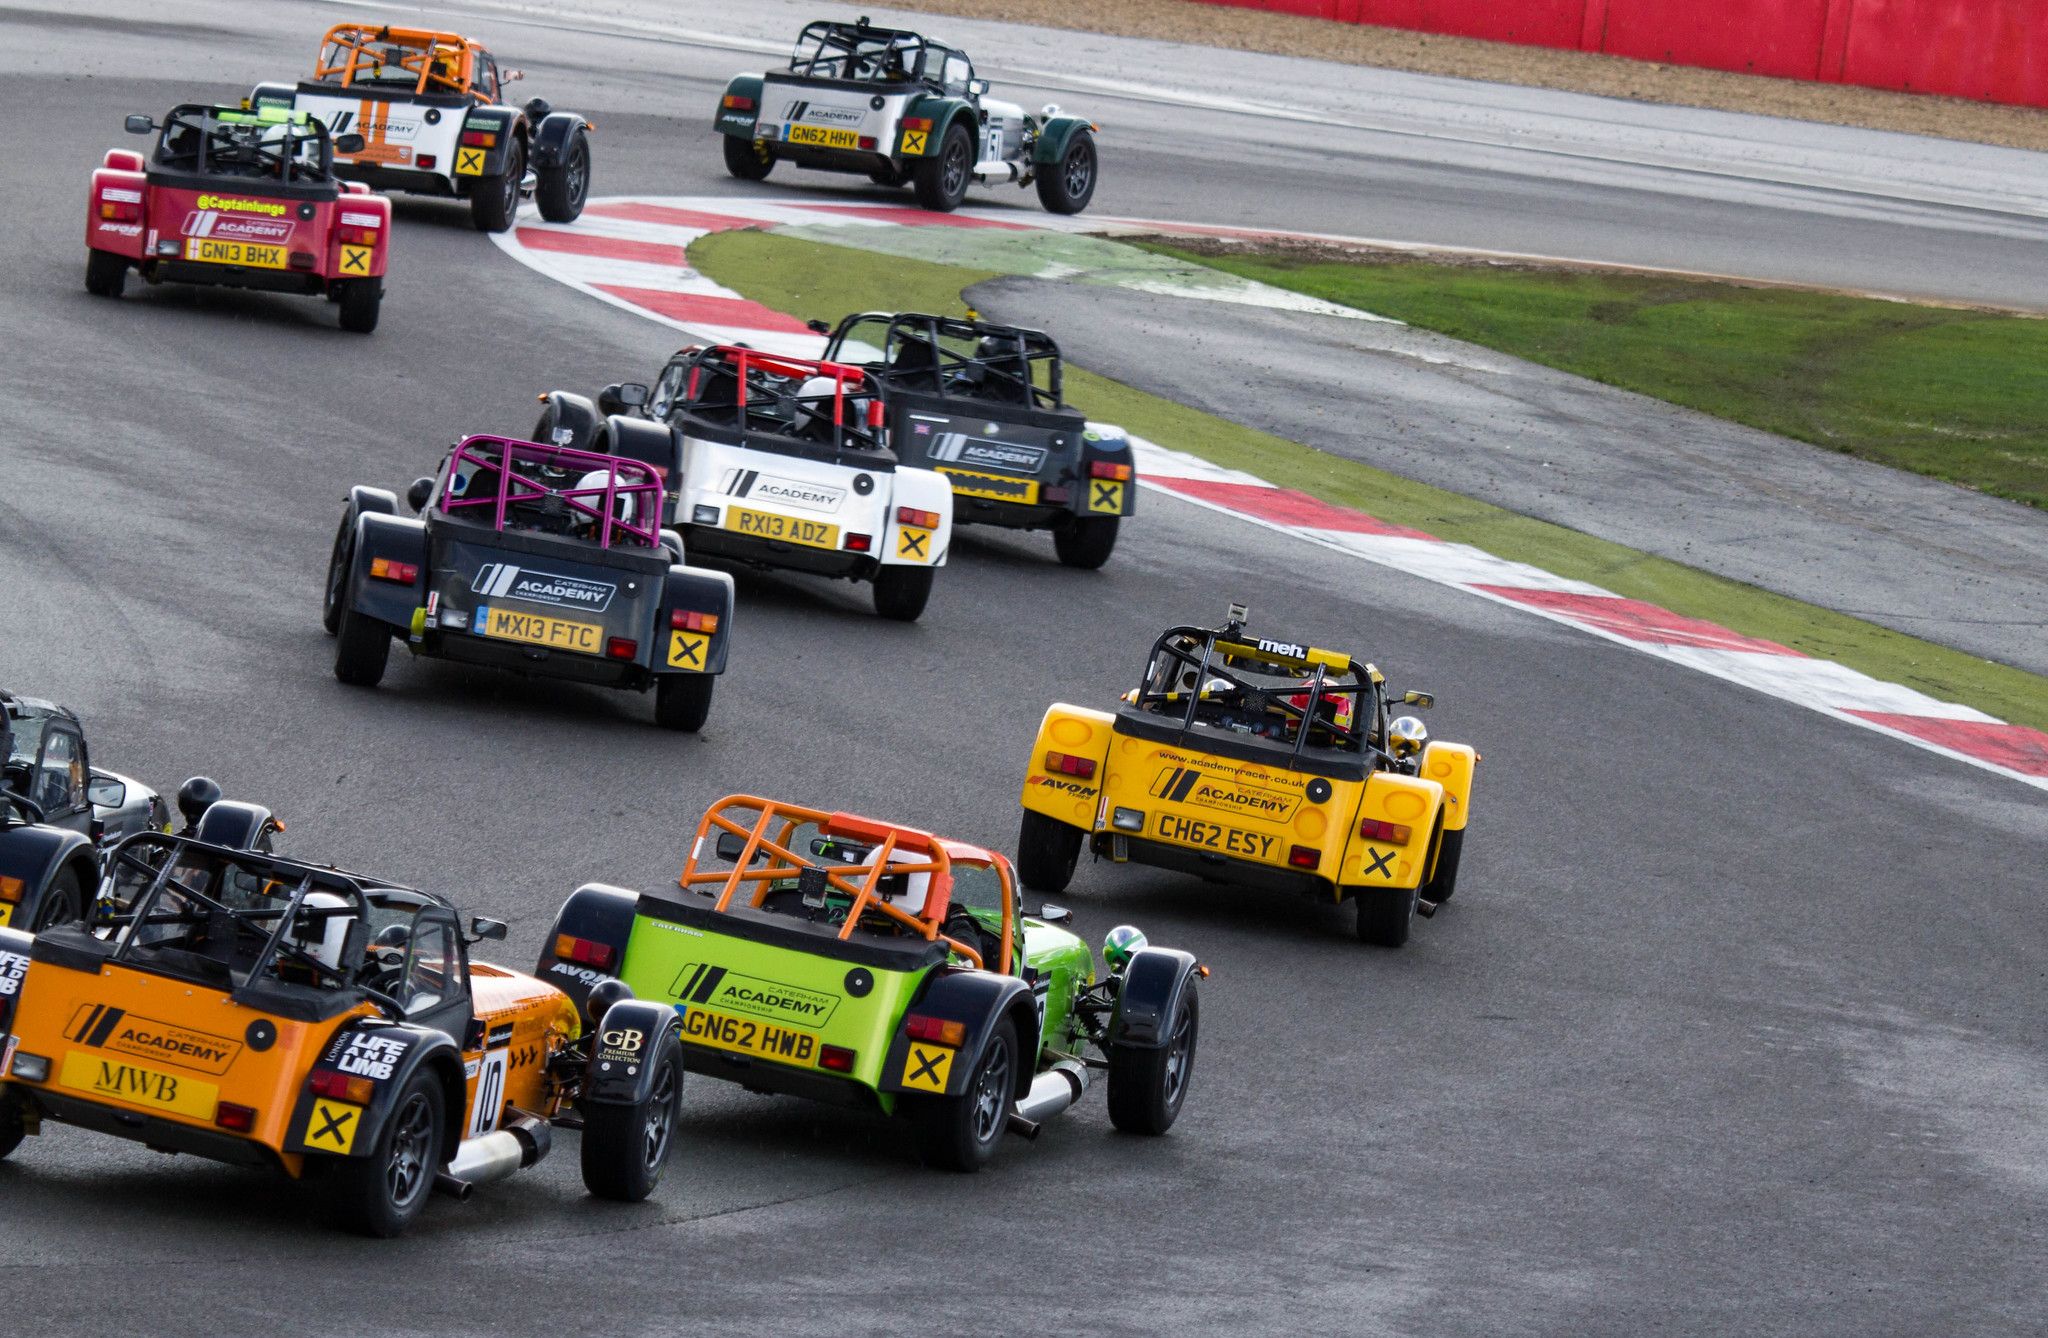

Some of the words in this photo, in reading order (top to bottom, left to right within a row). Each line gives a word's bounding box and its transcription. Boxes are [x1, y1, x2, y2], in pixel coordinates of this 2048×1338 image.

[353, 121, 414, 134] ACADEMY
[808, 110, 859, 121] ACADEMY
[792, 127, 828, 143] GN62
[829, 131, 857, 146] HHV
[216, 222, 286, 237] ACADEMY
[202, 242, 241, 259] GN13
[246, 247, 281, 265] BHX
[964, 447, 1039, 465] ACADEMY
[758, 485, 837, 505] ACADEMY
[740, 512, 785, 536] RX13
[789, 521, 828, 544] ADZ
[517, 580, 605, 603] ACADEMY
[495, 613, 545, 639] MX13
[550, 622, 594, 648] FTC
[1159, 751, 1305, 789] www.academyracer.co.uk
[1041, 778, 1099, 797] AVON
[1198, 786, 1290, 813] ACADEMY
[1158, 815, 1222, 848] CH62
[1225, 829, 1274, 858] ESY
[723, 985, 826, 1016] ACADEMY
[767, 986, 830, 1004] CATERHAM
[120, 1029, 228, 1062] ACADEMY
[324, 1031, 351, 1062] LONDON
[351, 1032, 409, 1057] LIFE
[602, 1029, 643, 1051] GB
[687, 1011, 757, 1048] GN62
[760, 1027, 814, 1061] HWB
[337, 1054, 394, 1080] LIMB
[344, 1046, 398, 1064] AND
[94, 1061, 178, 1102] MWB
[475, 1060, 502, 1133] 10
